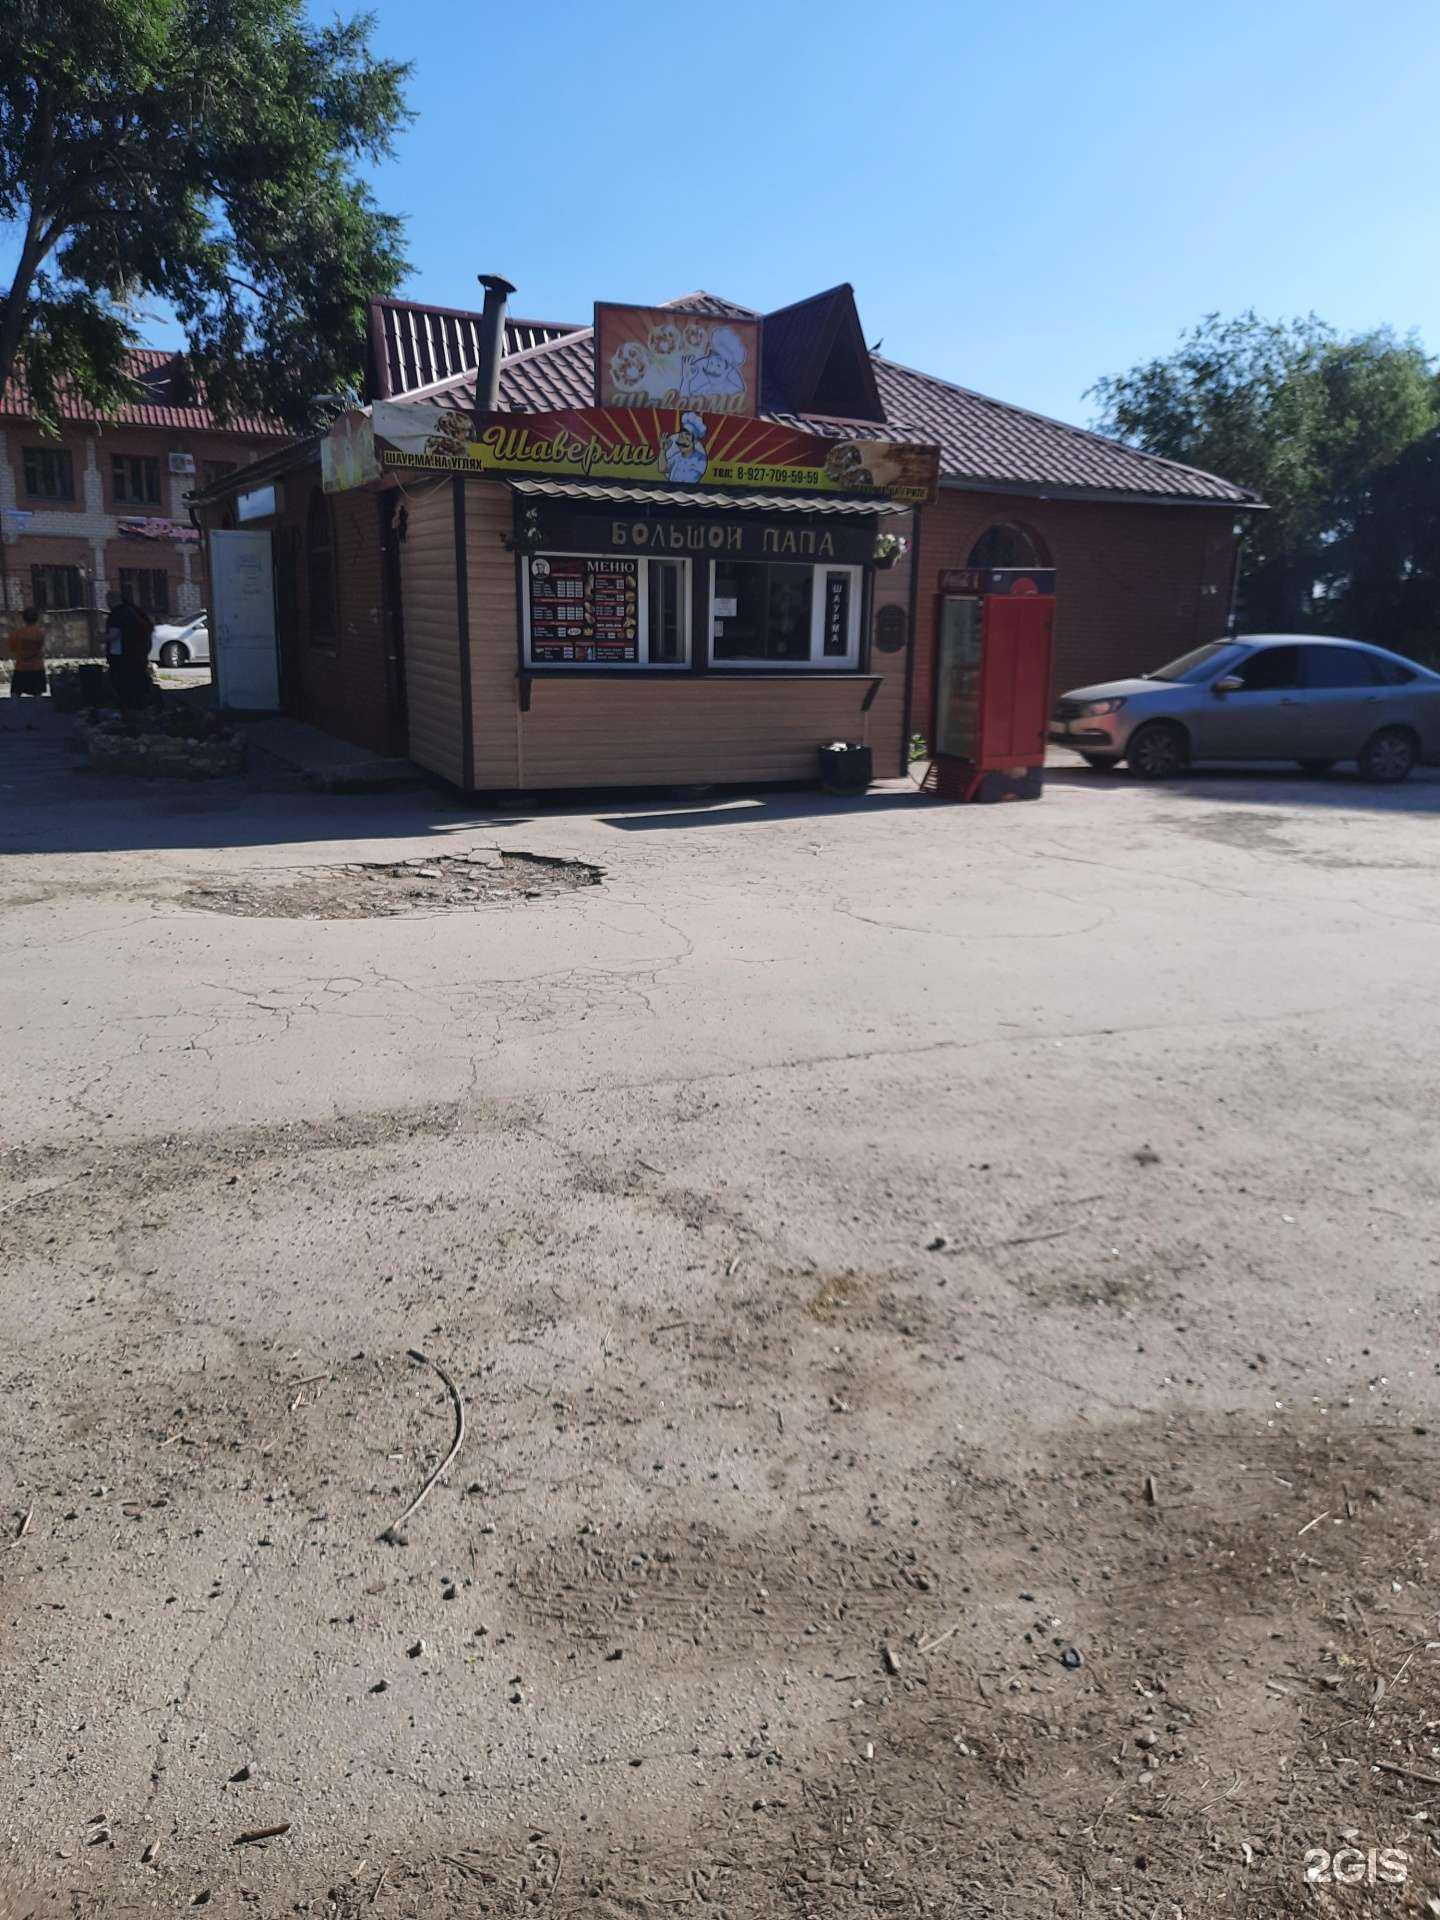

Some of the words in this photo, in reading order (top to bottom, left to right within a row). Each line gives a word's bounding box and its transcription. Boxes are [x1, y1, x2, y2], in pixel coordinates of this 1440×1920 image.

[385, 451, 432, 467] ШАУРМА
[434, 454, 447, 468] НА
[450, 456, 482, 471] УГЛЯХ
[482, 425, 657, 476] Шаверма
[737, 466, 819, 484] 8-927-709-59-59
[763, 529, 834, 556] ПАПА
[587, 561, 634, 573] МЕНЮ
[831, 583, 842, 642] ШАУРМА
